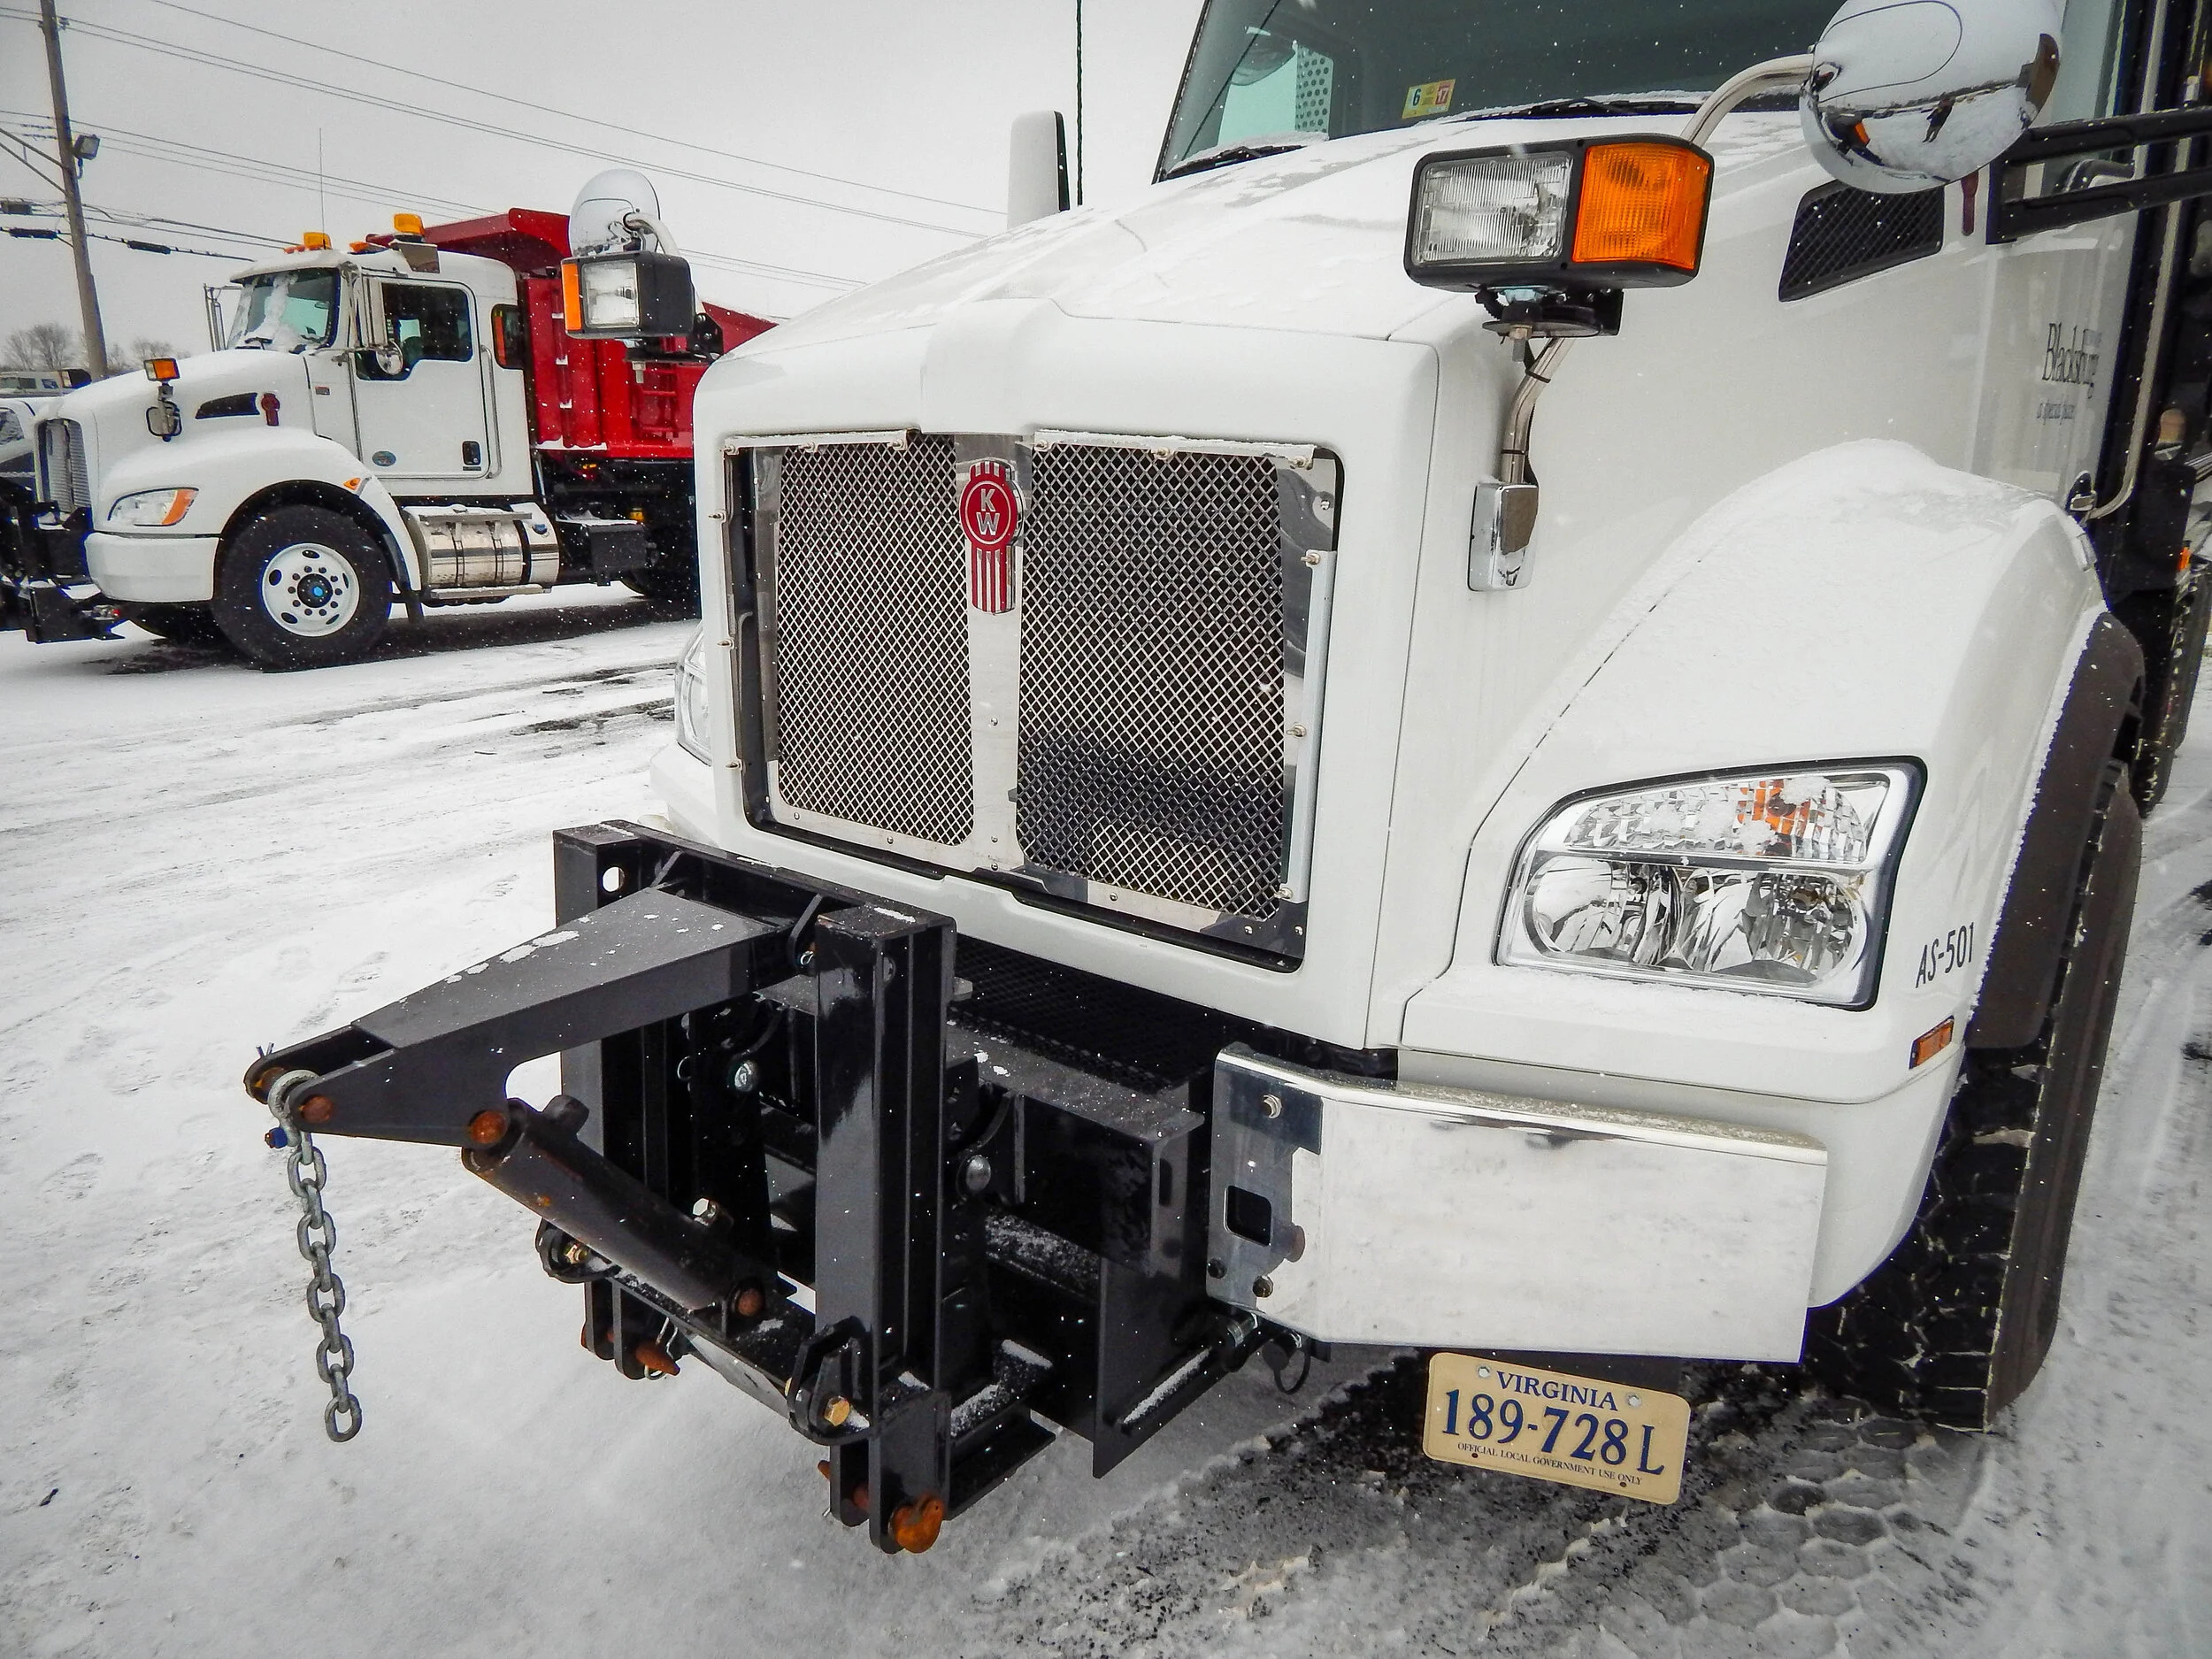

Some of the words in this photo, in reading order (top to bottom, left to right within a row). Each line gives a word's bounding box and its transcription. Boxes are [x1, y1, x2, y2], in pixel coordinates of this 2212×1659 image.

[1412, 88, 1421, 106] 6
[1437, 87, 1449, 104] 17
[980, 488, 996, 512] K
[976, 511, 1001, 536] W
[1916, 921, 1974, 988] AS-501
[1496, 1371, 1619, 1412] VIRGINIA
[1442, 1388, 1665, 1475] 189-728L
[1457, 1442, 1498, 1456] OFFICIAL
[1501, 1449, 1532, 1463] LOCAL
[1532, 1456, 1595, 1475] GOVERNMENT
[1599, 1469, 1616, 1480] USE
[1617, 1473, 1643, 1486] ONLY
